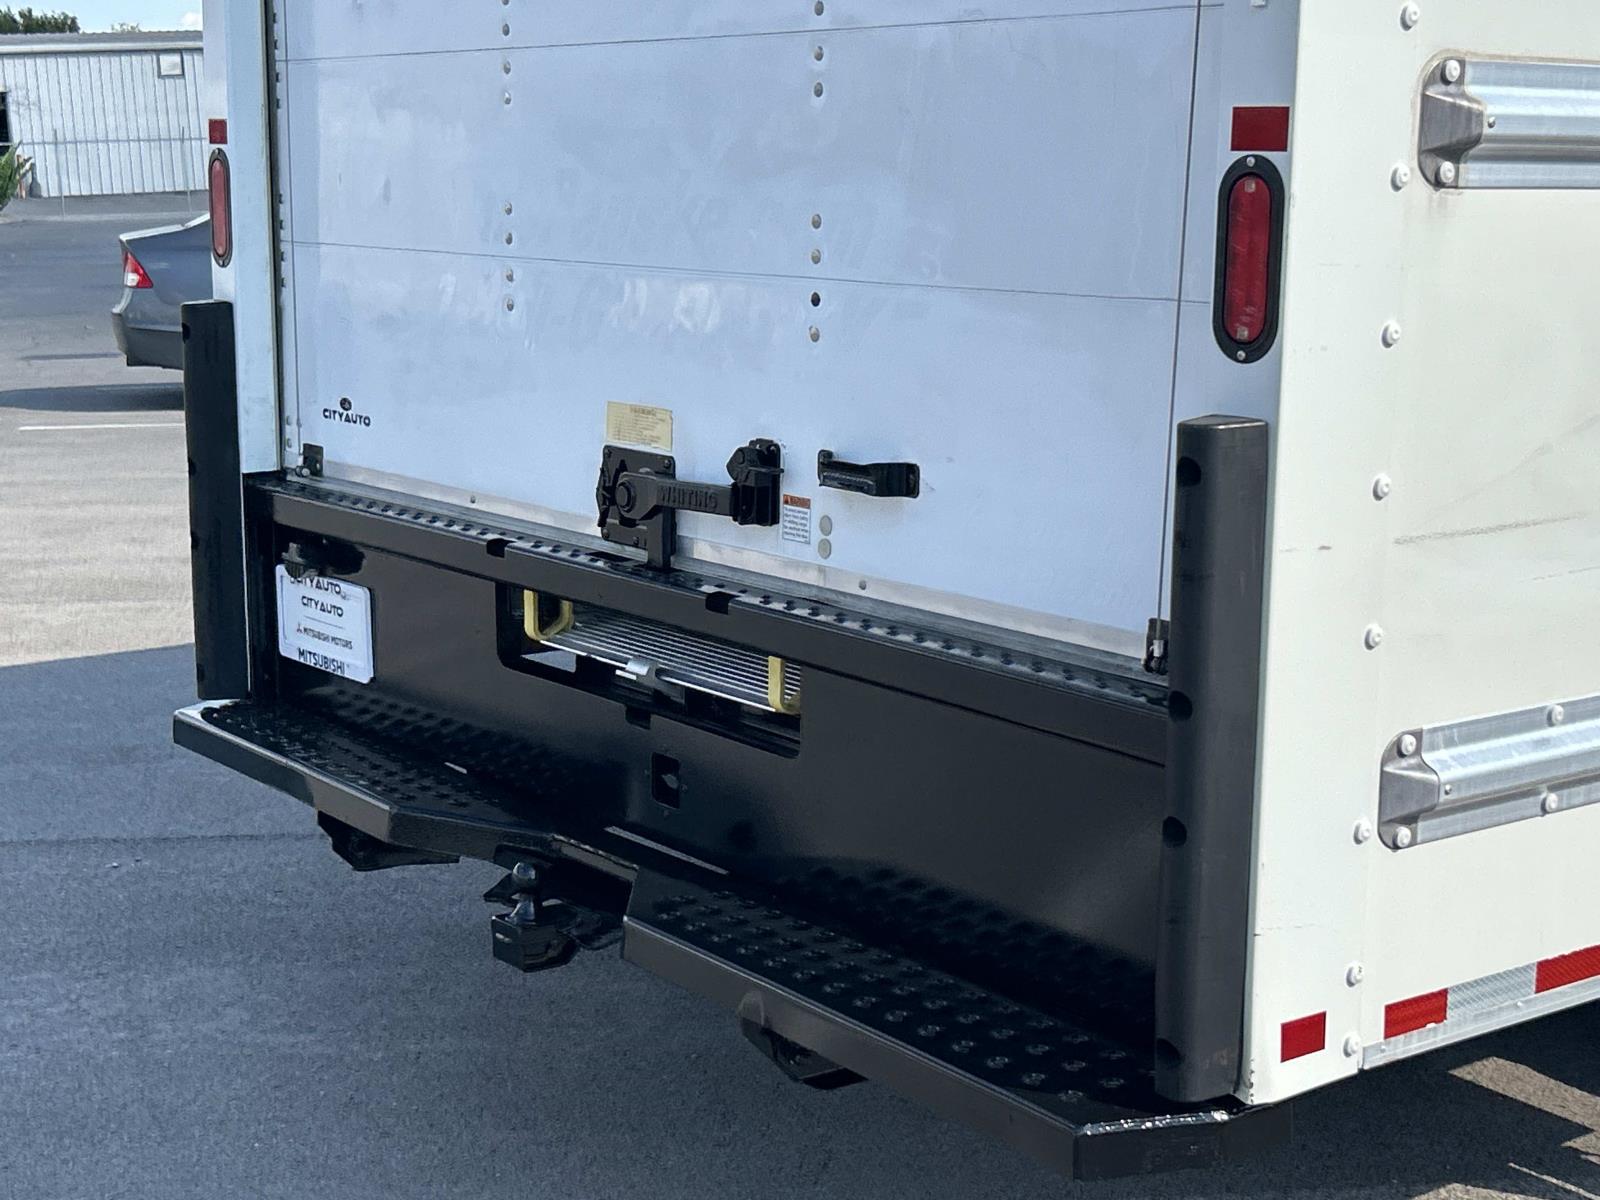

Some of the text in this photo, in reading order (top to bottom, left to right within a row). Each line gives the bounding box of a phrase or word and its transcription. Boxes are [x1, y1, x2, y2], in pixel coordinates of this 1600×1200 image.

[303, 627, 353, 650] MITSUBISHI MOTORS
[298, 647, 345, 675] MITSUBISHI
